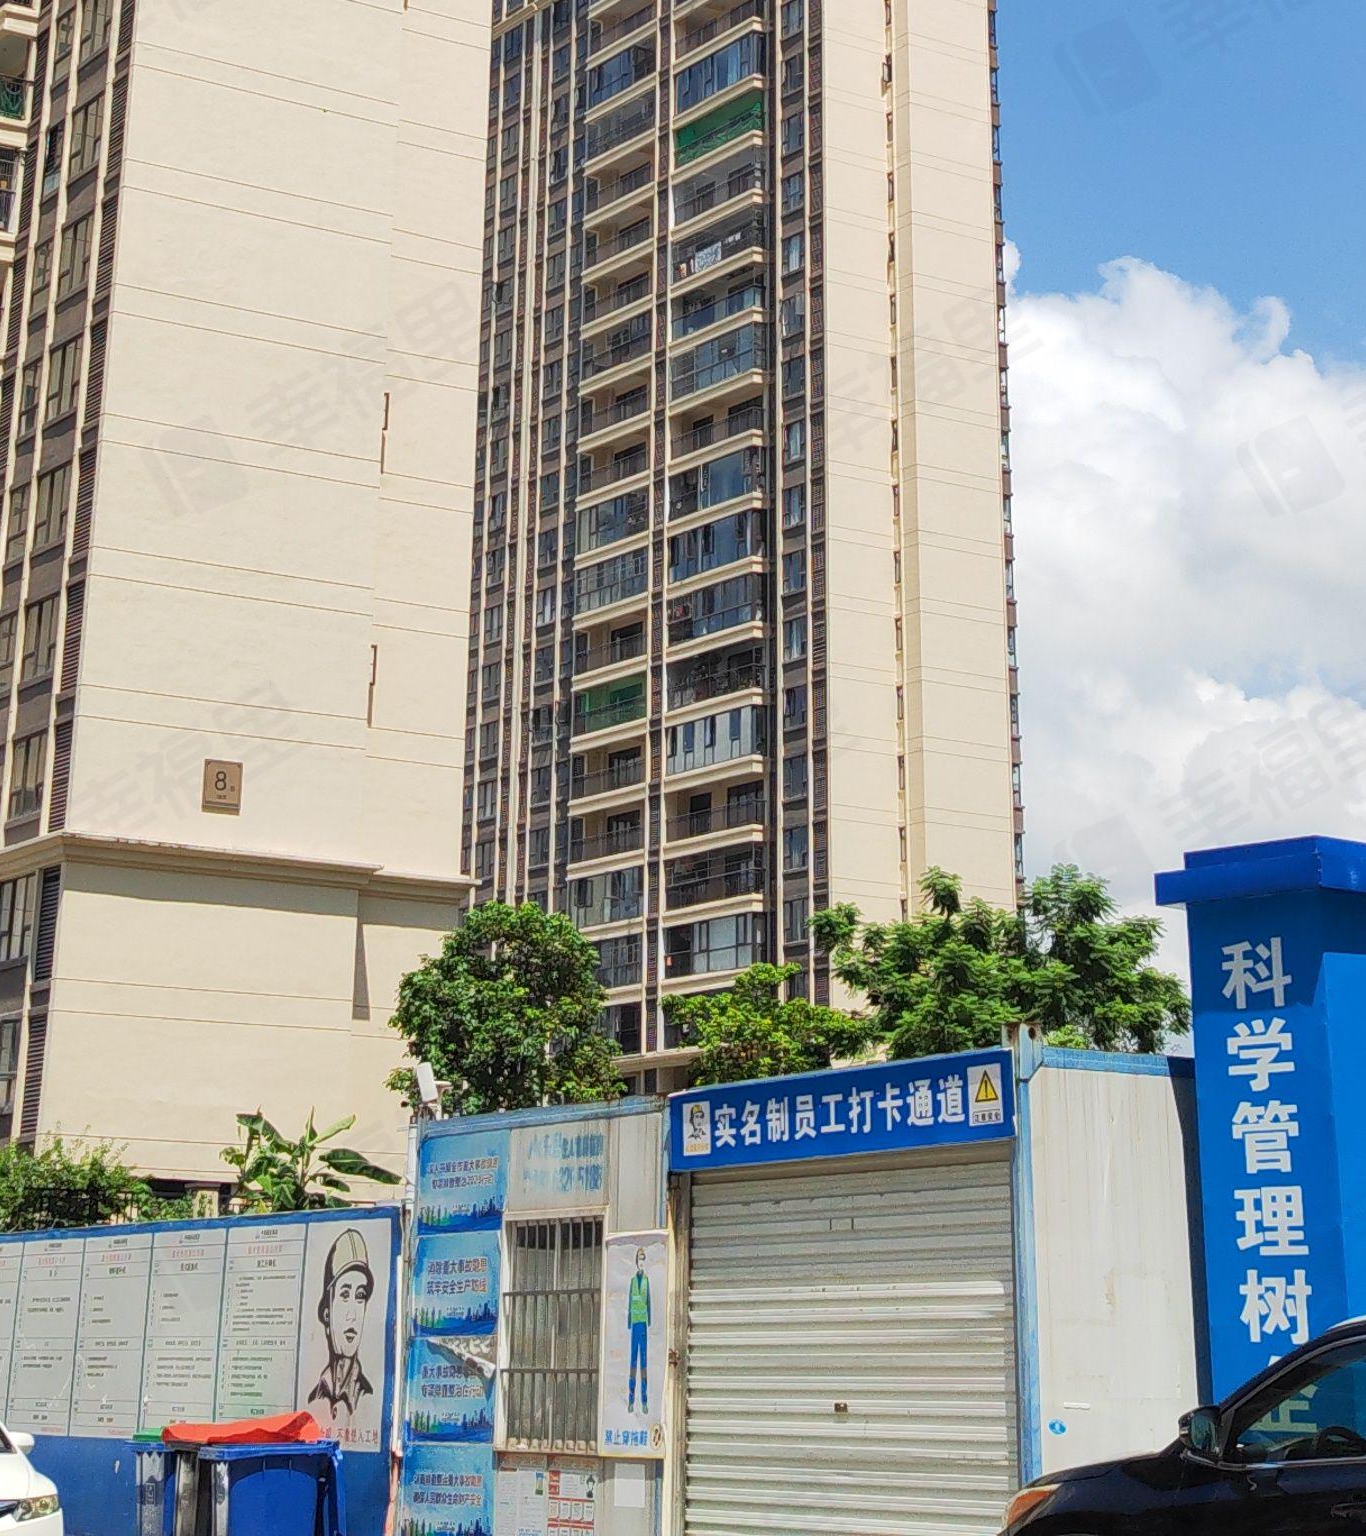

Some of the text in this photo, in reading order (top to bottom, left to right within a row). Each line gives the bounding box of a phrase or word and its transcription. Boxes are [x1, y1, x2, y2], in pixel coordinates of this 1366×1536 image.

[215, 771, 227, 791] 8
[714, 1074, 966, 1149] 实名制员工打卡通道
